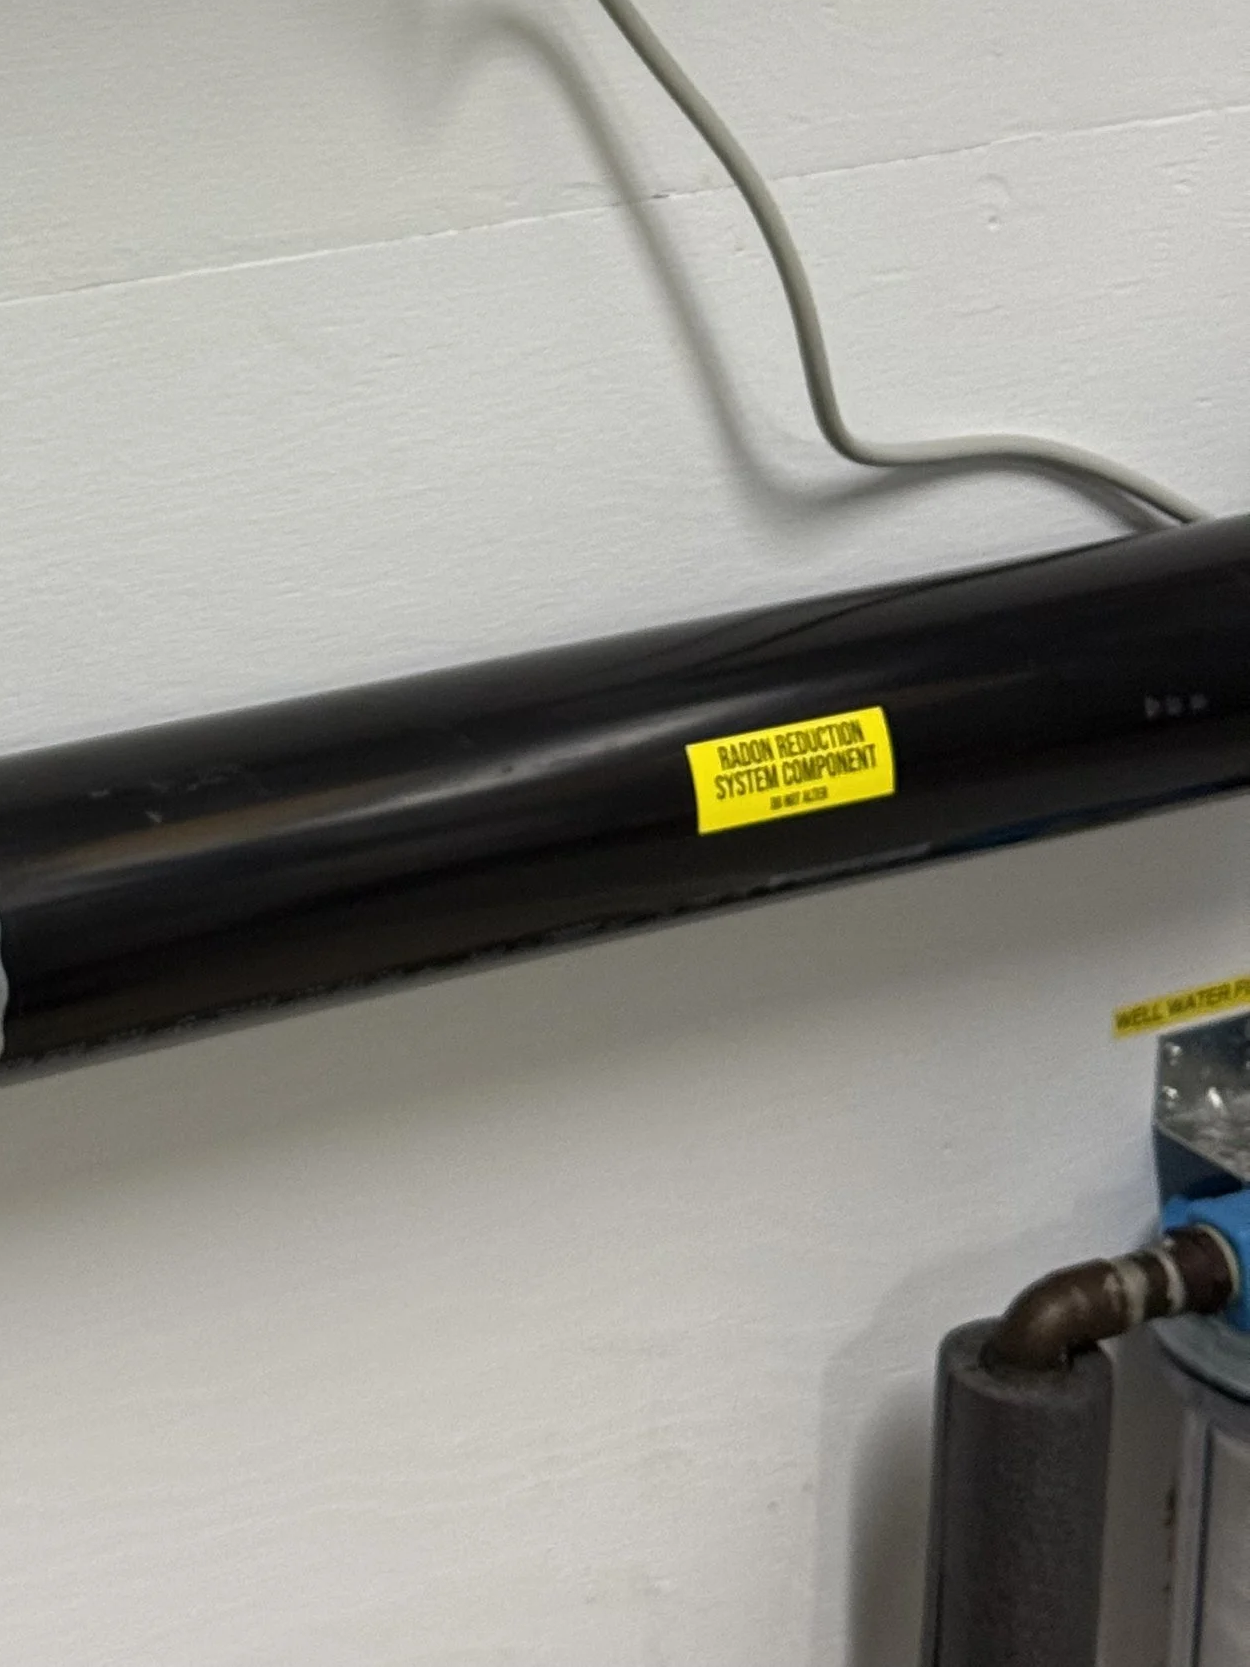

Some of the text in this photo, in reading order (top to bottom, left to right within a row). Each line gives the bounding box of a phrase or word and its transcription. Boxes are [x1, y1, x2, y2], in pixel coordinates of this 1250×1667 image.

[717, 720, 865, 770] RADON REDUCTION
[715, 744, 876, 800] SYSTEM COMPONENT
